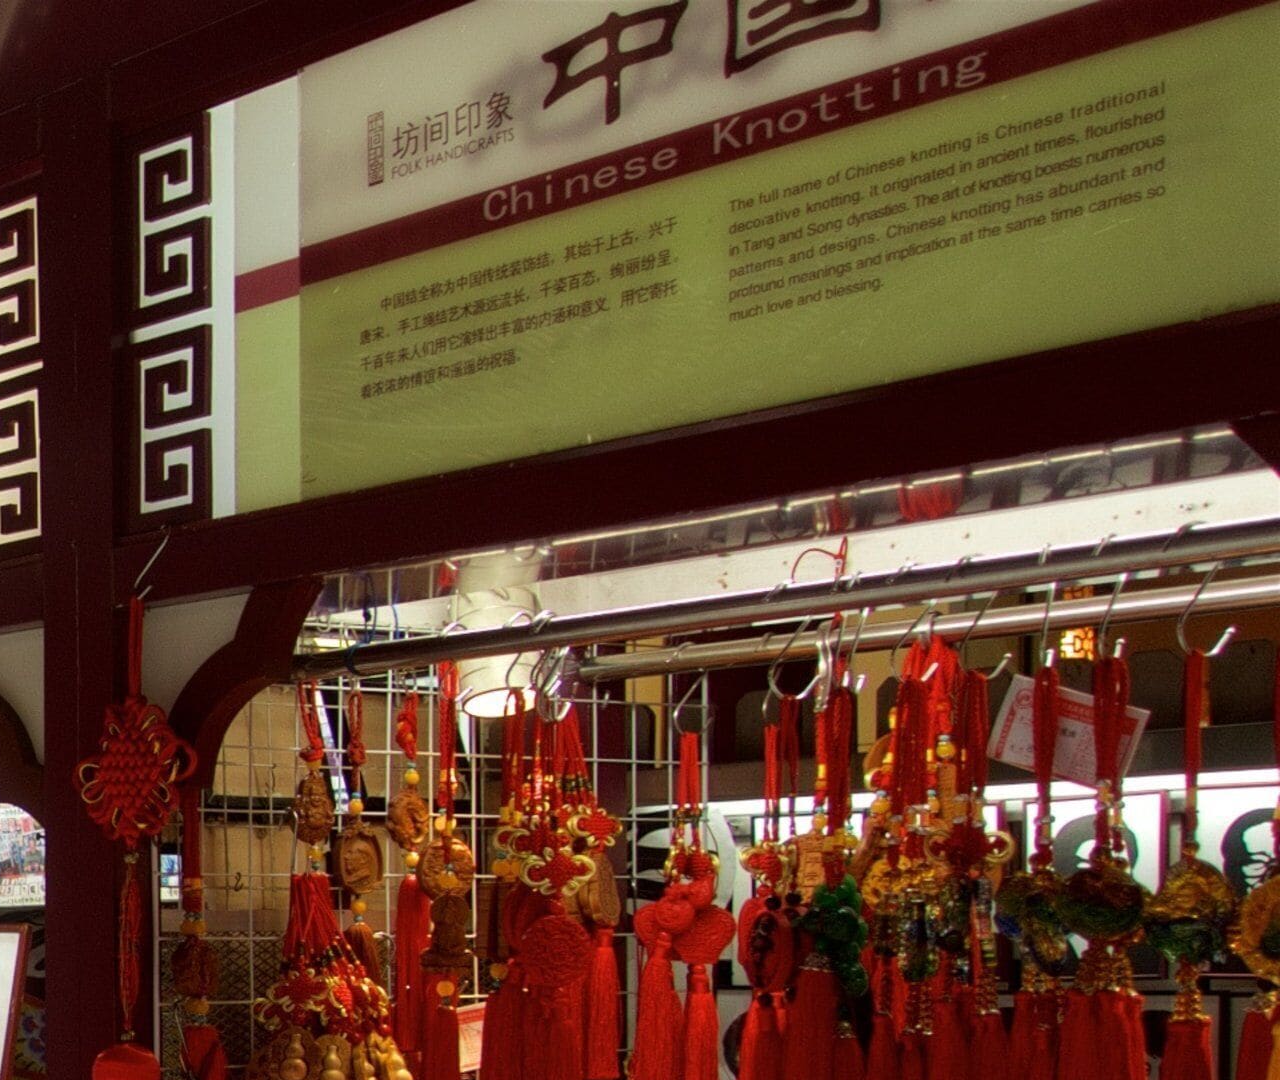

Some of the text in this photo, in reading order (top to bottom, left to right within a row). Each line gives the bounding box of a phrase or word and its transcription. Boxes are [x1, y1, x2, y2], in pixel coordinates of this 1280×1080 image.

[391, 128, 515, 179] FOLK HANDICRAFTS
[392, 92, 513, 158] 坊间印象
[483, 147, 678, 222] Chinese
[713, 51, 987, 154] Knotting
[728, 82, 1164, 212] The full name of Chinese knotting is Chinese traditional
[728, 205, 799, 235] decorative
[883, 162, 954, 196] originated
[960, 158, 971, 173] in
[976, 142, 1028, 169] ancient
[1084, 105, 1164, 140] flourished
[728, 243, 738, 257] in
[743, 233, 774, 256] Tang
[778, 227, 800, 244] and
[807, 215, 841, 239] Song
[913, 190, 938, 210] The
[942, 186, 960, 202] art
[963, 181, 975, 197] of
[979, 166, 1031, 195] knotting
[1034, 154, 1080, 178] boasts
[1086, 133, 1164, 165] numerous
[728, 255, 783, 282] patterns
[788, 246, 813, 264] and
[886, 211, 945, 240] Chinese
[951, 196, 1010, 227] knotting
[1016, 187, 1043, 207] has
[1048, 166, 1124, 200] abundant
[1132, 156, 1164, 178] and
[728, 184, 1164, 303] profound meanings and implication at the same time carries so
[728, 303, 762, 323] much
[767, 295, 792, 313] love
[797, 288, 819, 305] and
